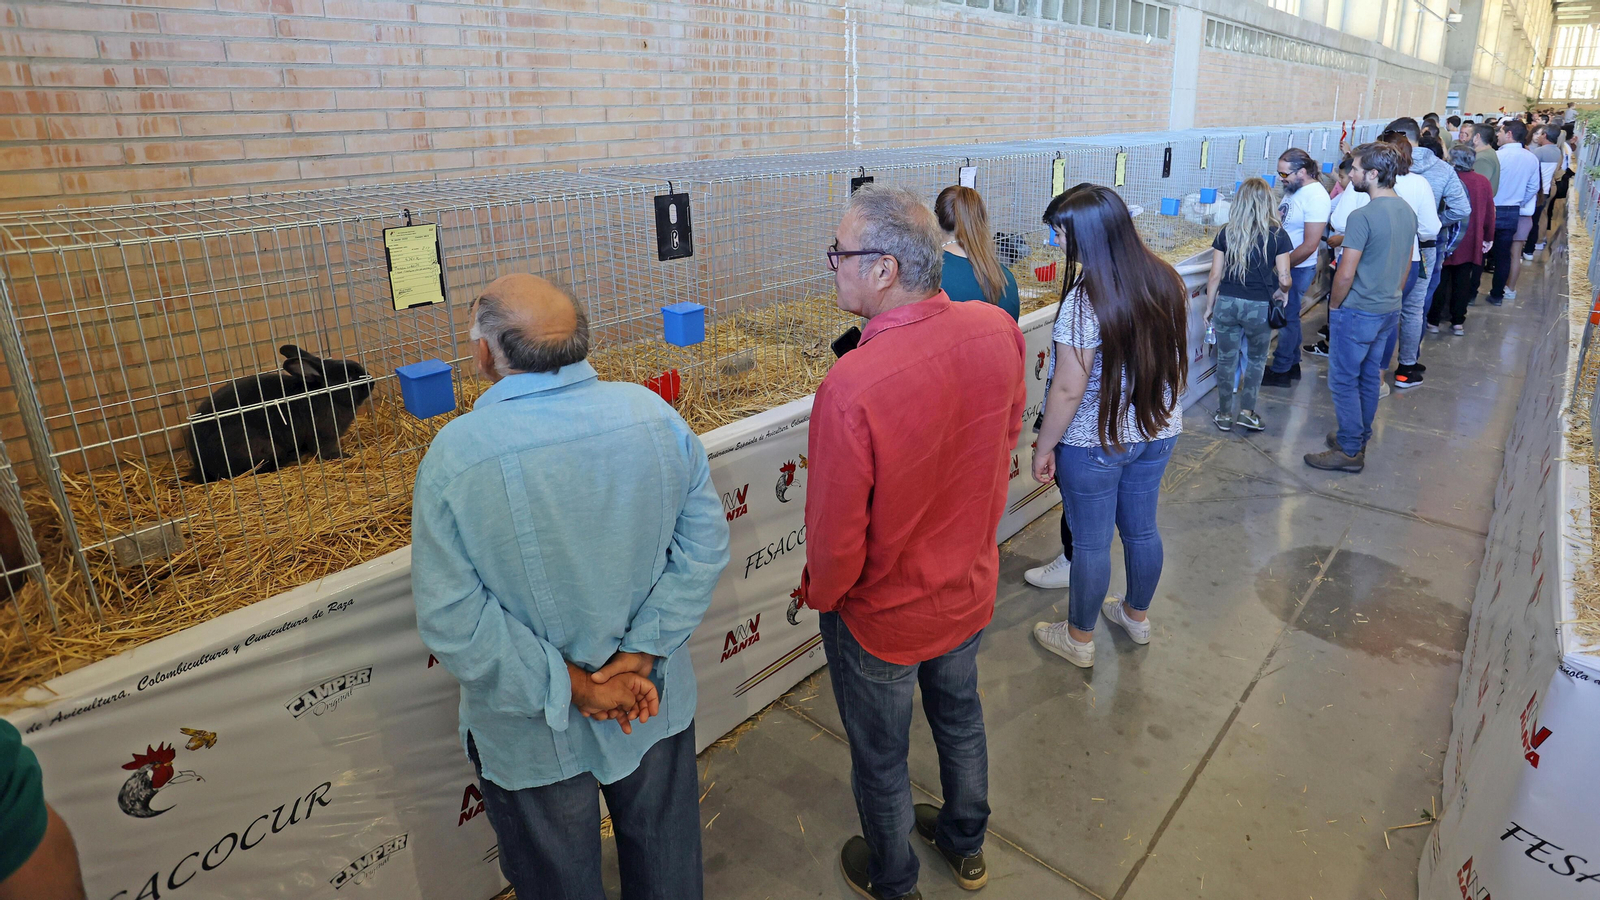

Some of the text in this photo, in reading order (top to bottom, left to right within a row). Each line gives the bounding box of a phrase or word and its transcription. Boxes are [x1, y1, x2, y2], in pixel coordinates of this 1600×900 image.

[726, 504, 748, 522] NTA
[745, 525, 807, 579] FESACO
[26, 723, 42, 734] de
[137, 648, 230, 691] Colombicultura
[233, 644, 240, 654] y
[245, 617, 310, 646] Cunicultura
[312, 610, 324, 620] de
[328, 599, 355, 614] Raza
[720, 632, 760, 663] NANTA
[1558, 664, 1589, 681] añola
[287, 668, 371, 718] CAMPER
[313, 684, 354, 716] Original
[109, 781, 332, 900] ACOCUR
[331, 834, 407, 889] CAMPER
